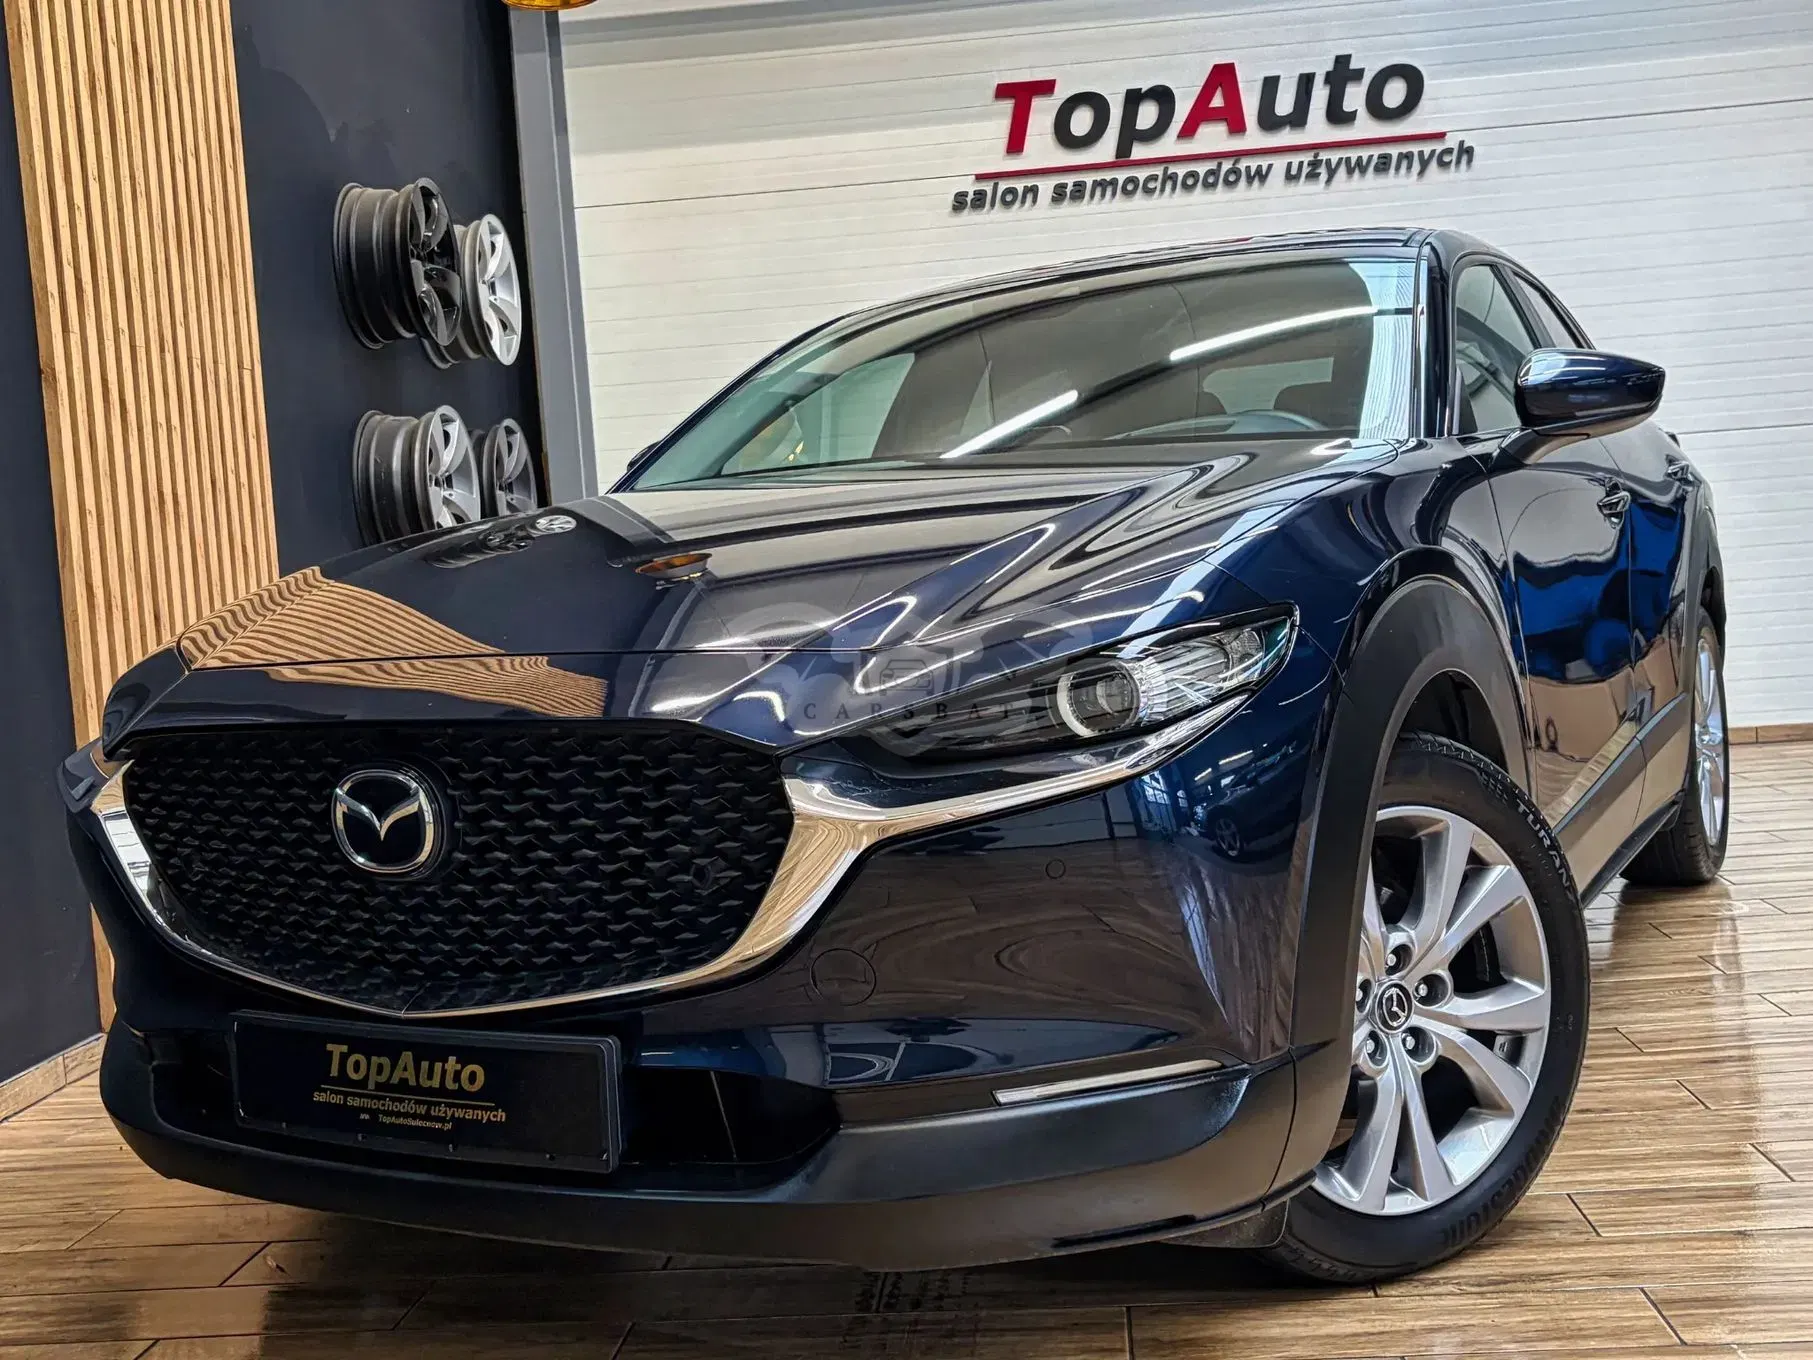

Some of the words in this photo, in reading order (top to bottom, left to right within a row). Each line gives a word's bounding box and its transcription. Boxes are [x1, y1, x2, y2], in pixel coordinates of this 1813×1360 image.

[994, 53, 1426, 160] TopAuto
[951, 181, 1040, 213] salon
[1050, 159, 1275, 206] samochodów
[1284, 140, 1476, 186] używanych
[325, 1043, 486, 1092] TopAuto
[312, 1090, 345, 1105] salon
[346, 1096, 428, 1116] samochodów
[430, 1104, 507, 1124] używanych
